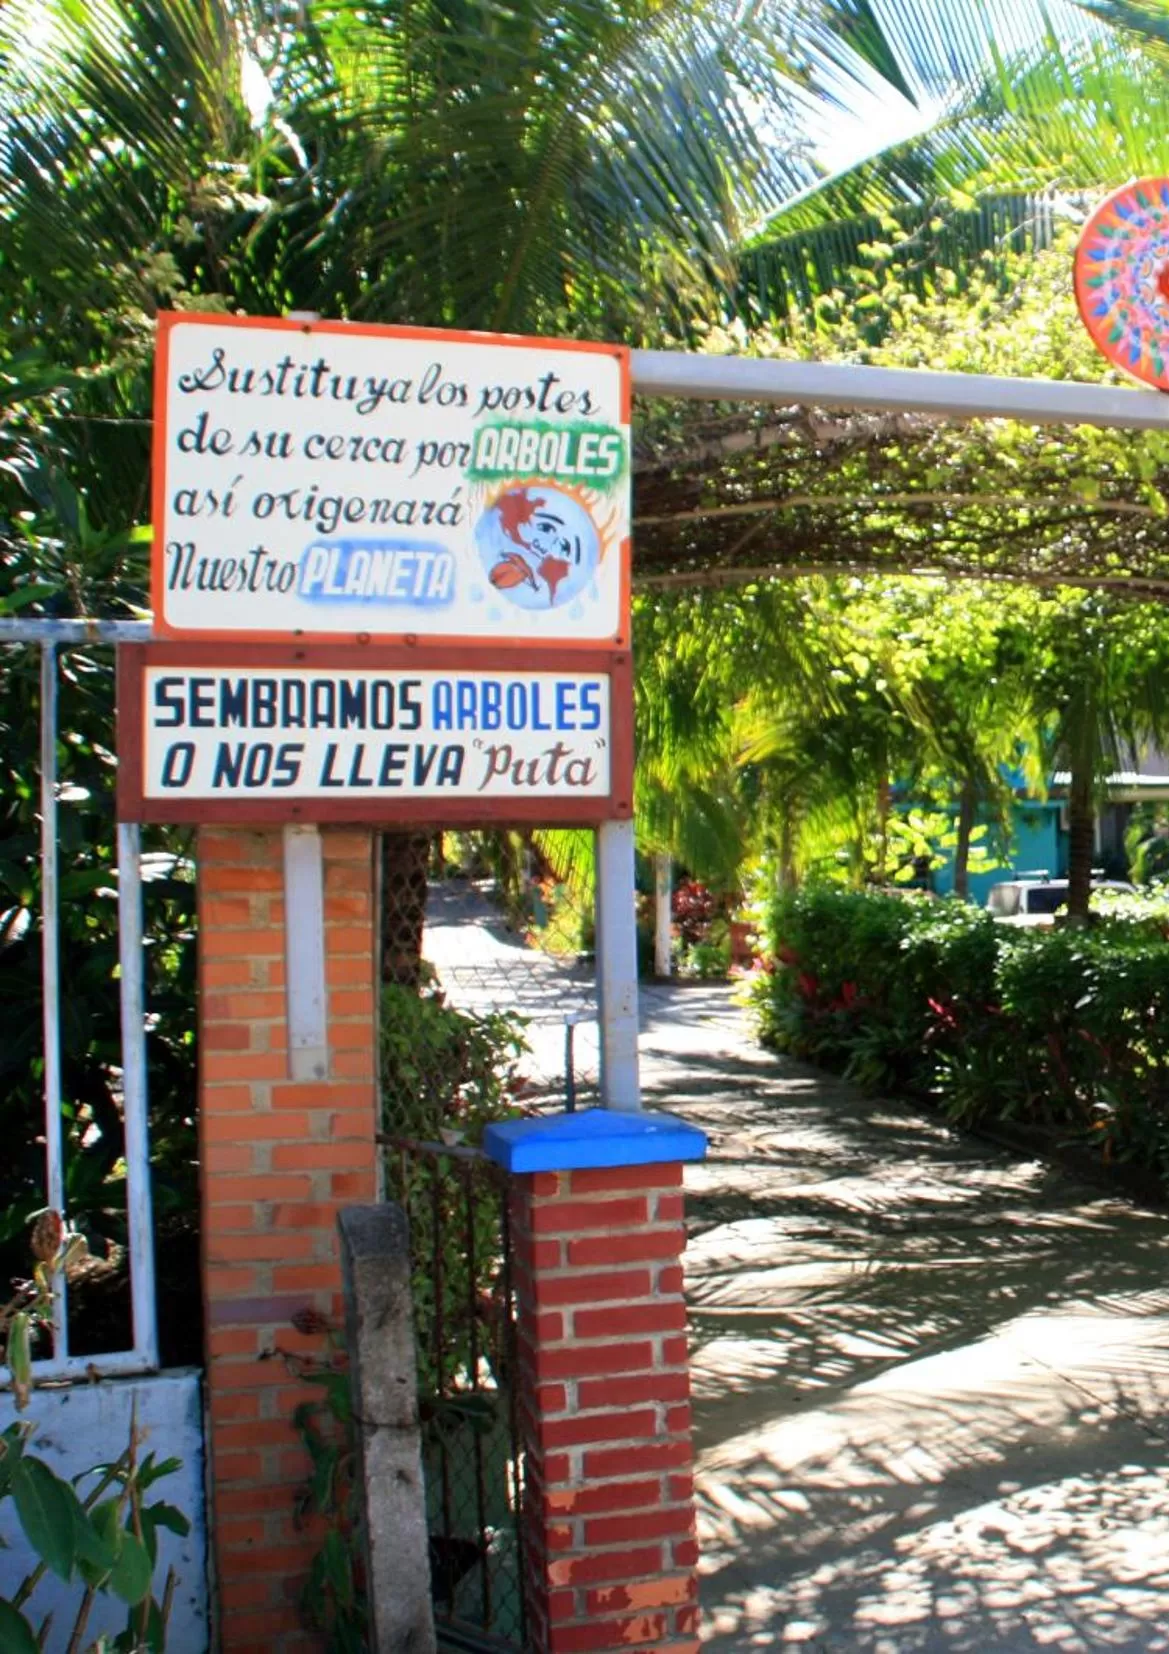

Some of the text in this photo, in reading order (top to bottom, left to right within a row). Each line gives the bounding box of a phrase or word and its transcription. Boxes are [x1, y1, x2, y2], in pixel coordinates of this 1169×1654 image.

[177, 347, 600, 419] Sustituya los postes
[176, 411, 621, 479] de su cerca por ARBOLES
[172, 474, 244, 518] así
[166, 541, 454, 599] Nuestro PLANETA
[154, 676, 601, 731] SEMBRAMOS ARBOLES
[160, 741, 196, 788] O
[211, 741, 305, 788] NOS
[319, 743, 465, 788] LLEVA
